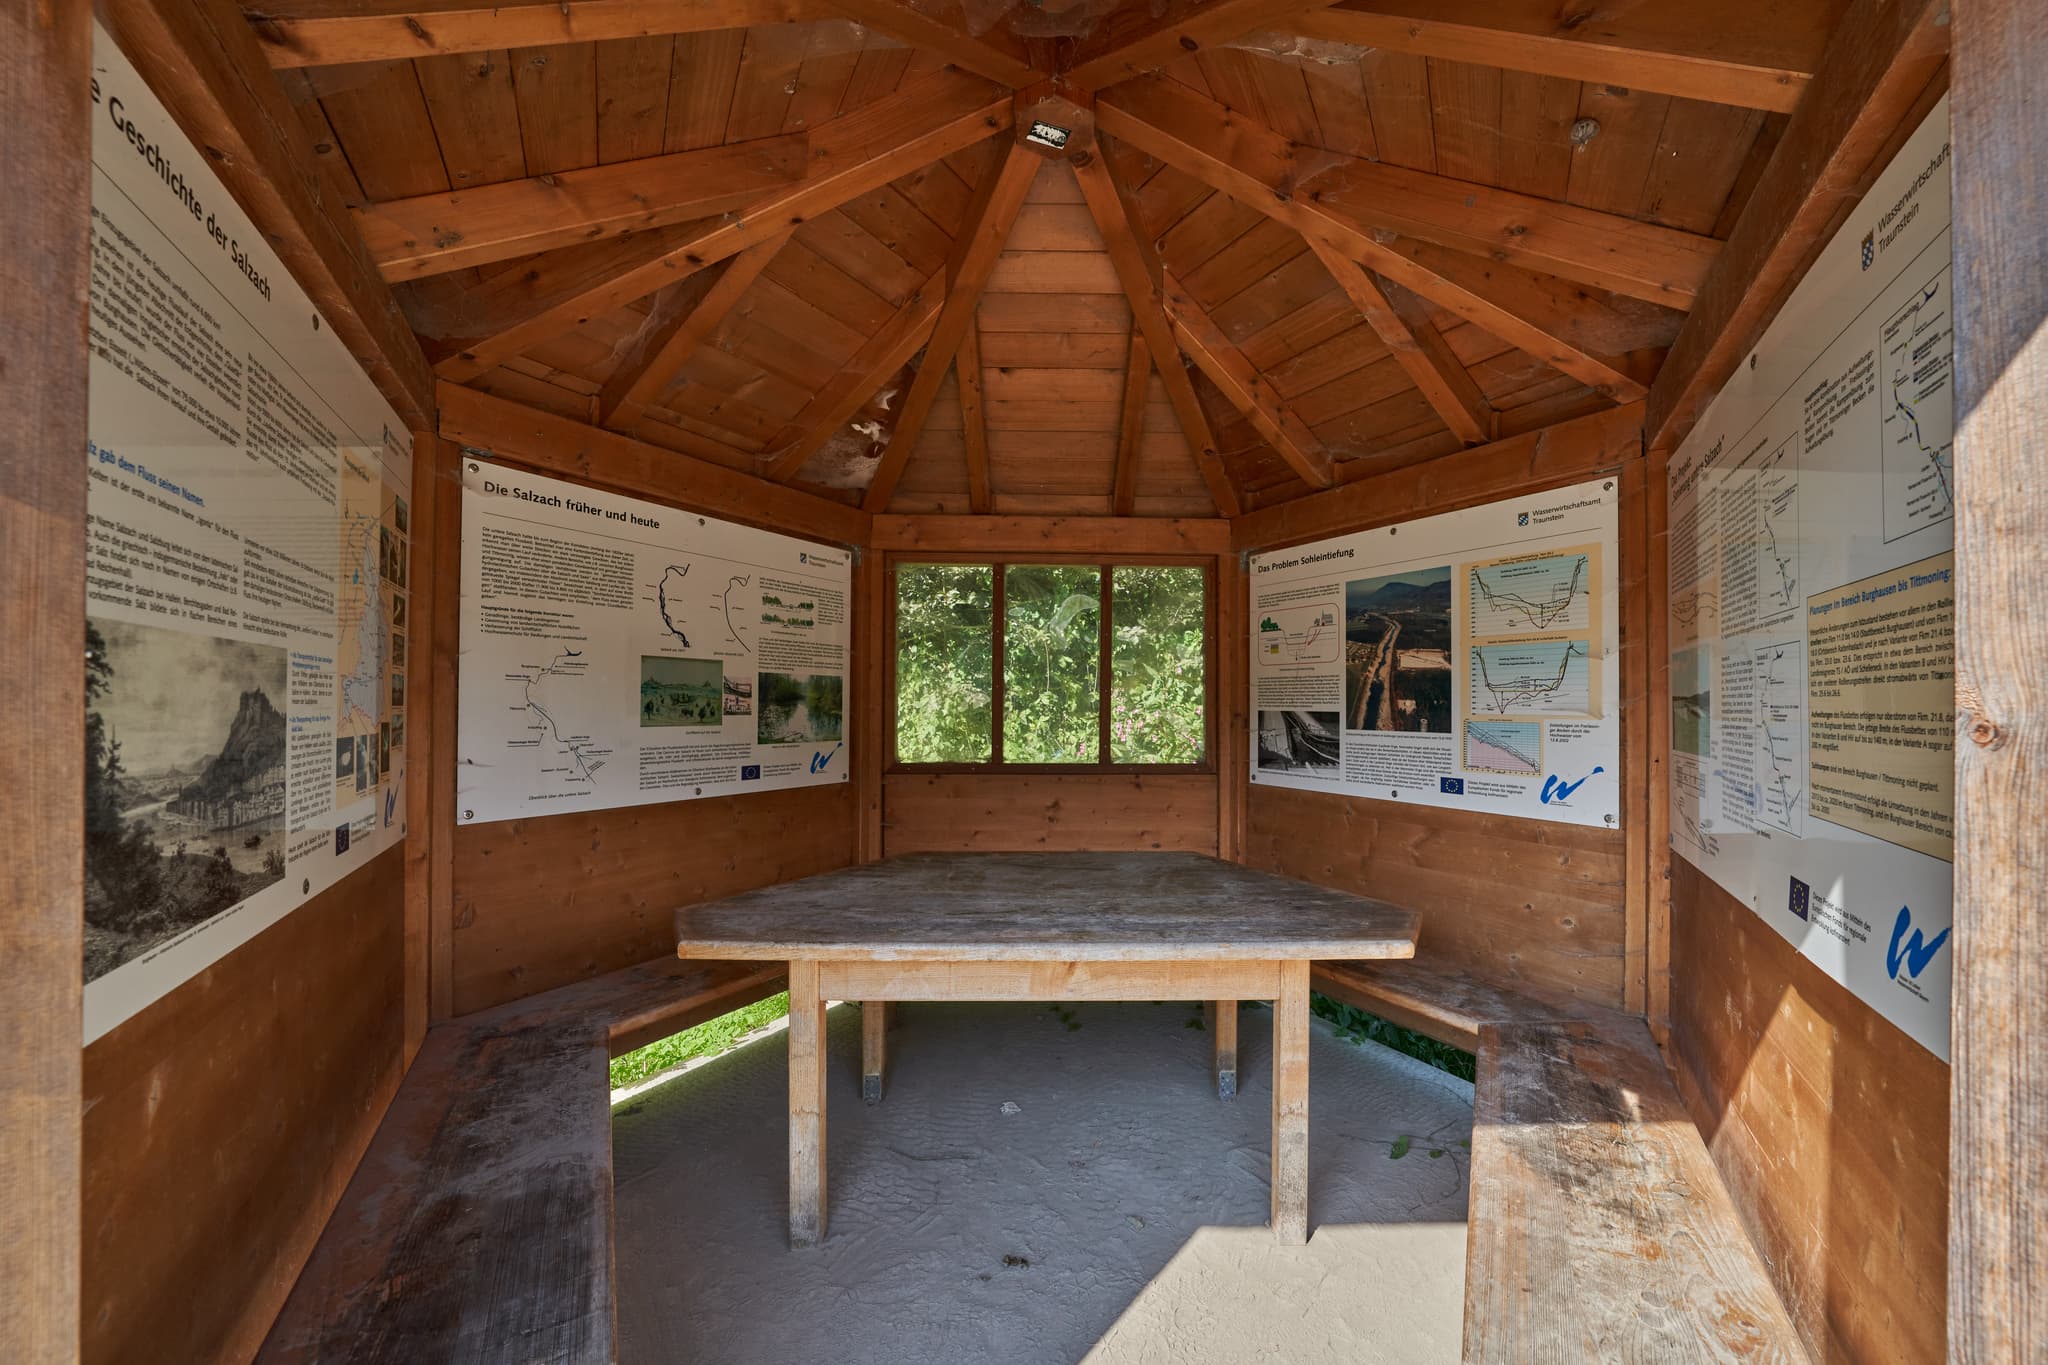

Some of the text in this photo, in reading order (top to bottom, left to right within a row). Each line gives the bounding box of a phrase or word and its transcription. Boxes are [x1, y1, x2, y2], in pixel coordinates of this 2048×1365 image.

[109, 97, 270, 302] Geschichte der Salzach
[1878, 203, 1919, 253] Traunstein
[99, 450, 203, 507] gab dem Fluss seinen Namen.
[484, 481, 660, 529] Die Salzach früher und heute
[1533, 498, 1600, 516] Wasserwirtschaftsamt
[1533, 514, 1564, 525] Traunstein
[1258, 548, 1354, 574] Das Problem Sohleintiefung
[1841, 593, 1860, 607] Bereich
[1862, 586, 1896, 602] Burghausen
[1898, 580, 1908, 592] bis
